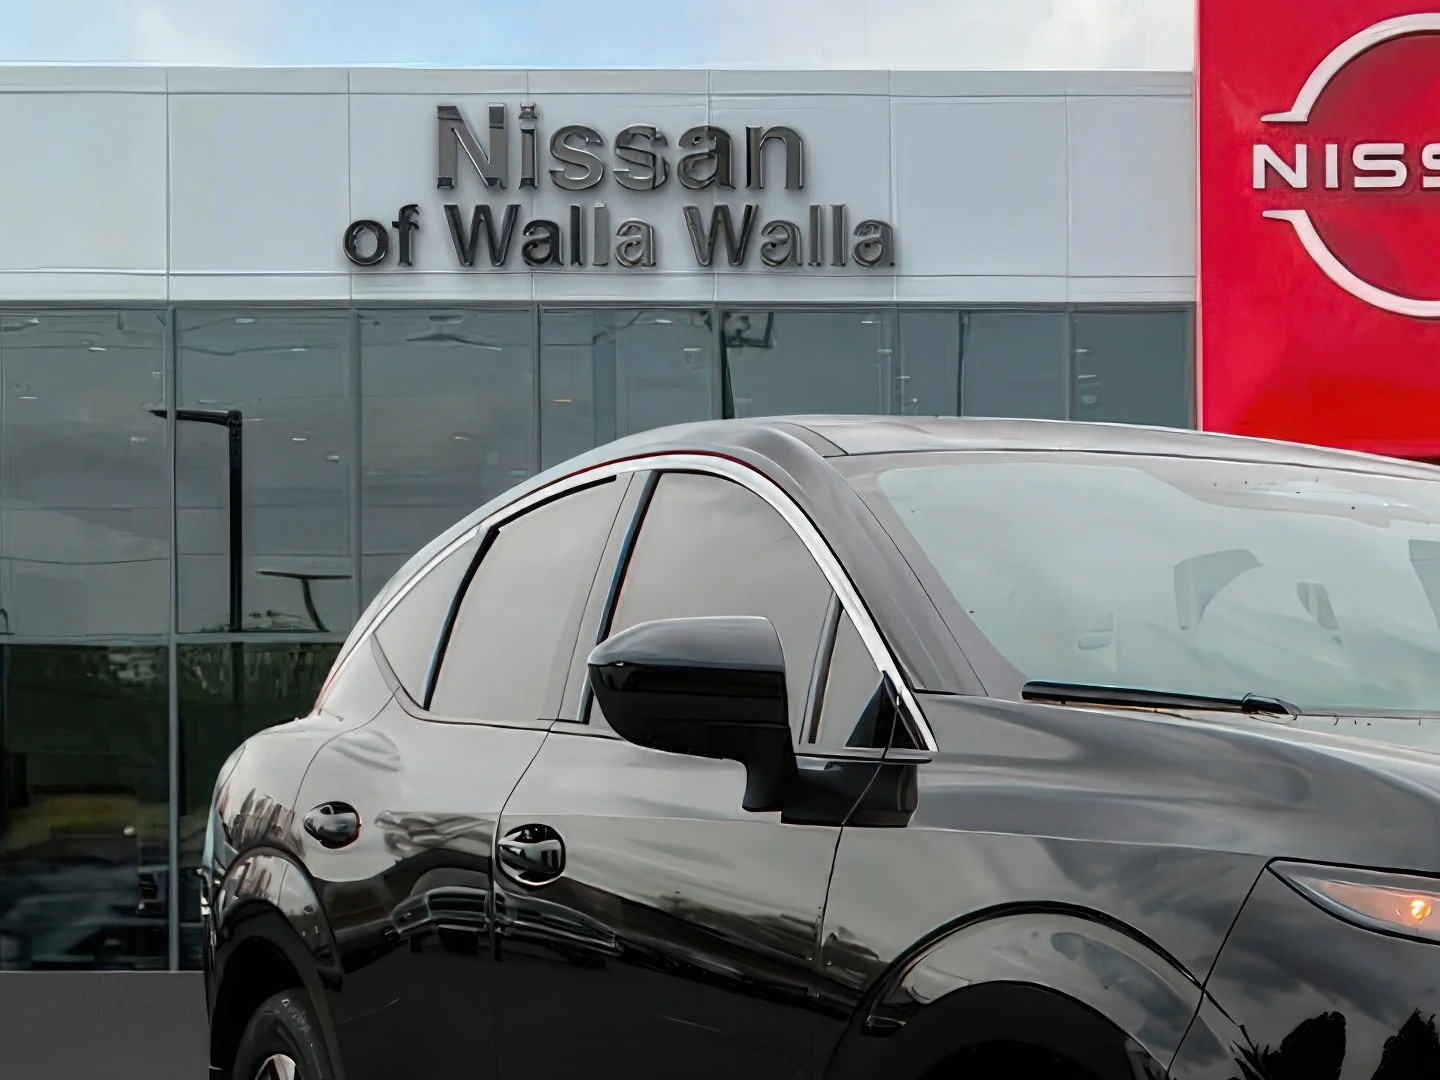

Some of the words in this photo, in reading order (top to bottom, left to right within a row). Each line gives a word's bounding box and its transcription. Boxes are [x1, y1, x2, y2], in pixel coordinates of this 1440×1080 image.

[437, 102, 804, 191] Nissan
[343, 203, 421, 267] of
[443, 203, 657, 267] Walla
[682, 203, 896, 267] Walla
